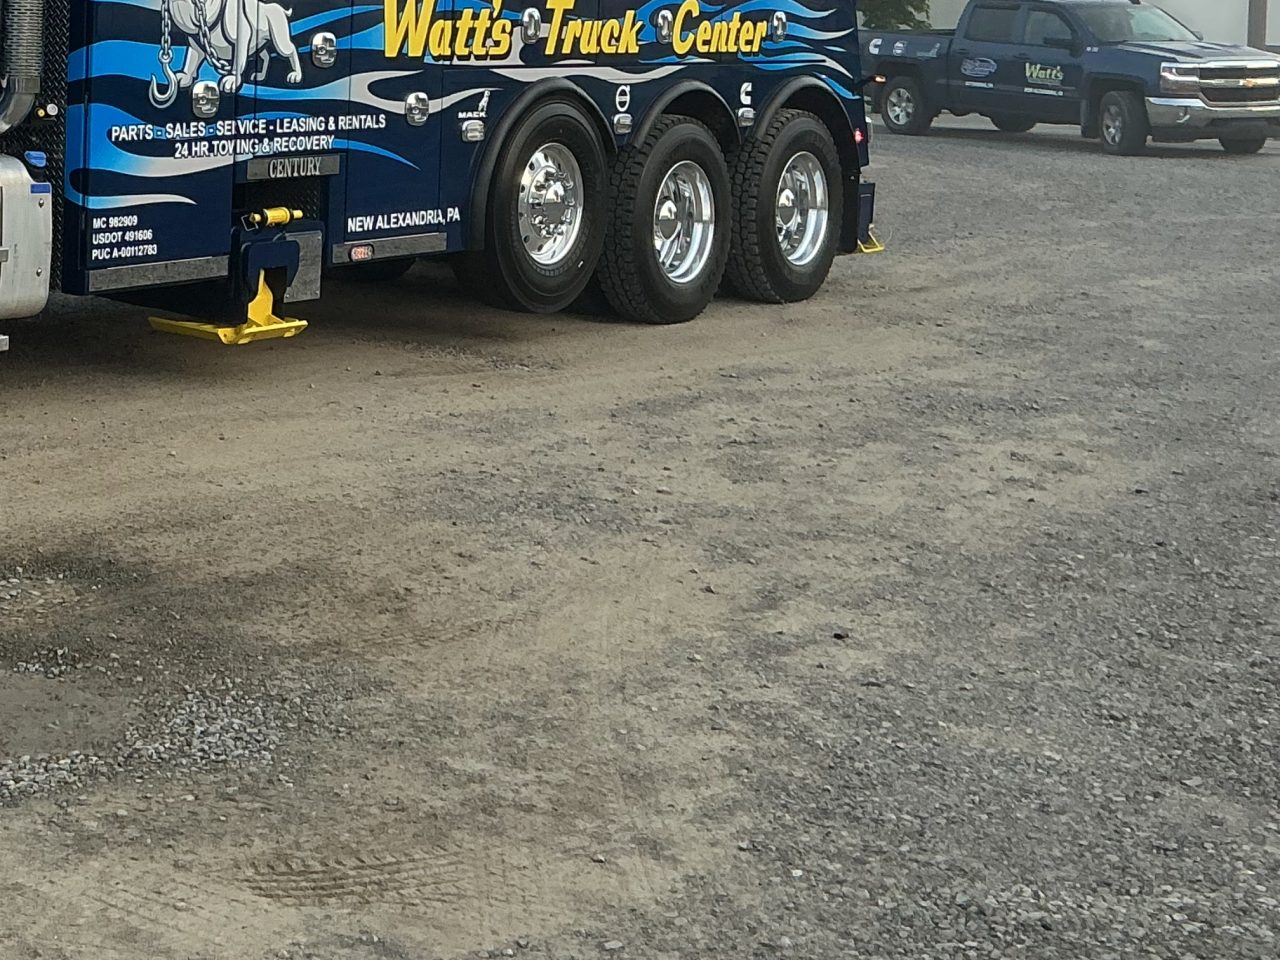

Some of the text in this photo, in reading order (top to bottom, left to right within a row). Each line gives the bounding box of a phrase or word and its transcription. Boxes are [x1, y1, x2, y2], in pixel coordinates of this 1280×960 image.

[457, 111, 487, 119] MACK
[111, 124, 154, 142] PARTS
[165, 121, 206, 139] SALES
[276, 116, 326, 133] LEASING
[327, 115, 336, 131] &
[338, 113, 387, 130] RENTALS
[174, 142, 189, 158] 24
[261, 137, 271, 153] &
[273, 135, 335, 152] RECOVERY
[269, 156, 322, 178] CENTURY
[92, 215, 138, 229] MC 982909
[347, 206, 461, 233] NEW ALEXANDRIA, PA
[92, 229, 153, 245] USDOT 491606
[91, 244, 158, 261] PUC A-00112783
